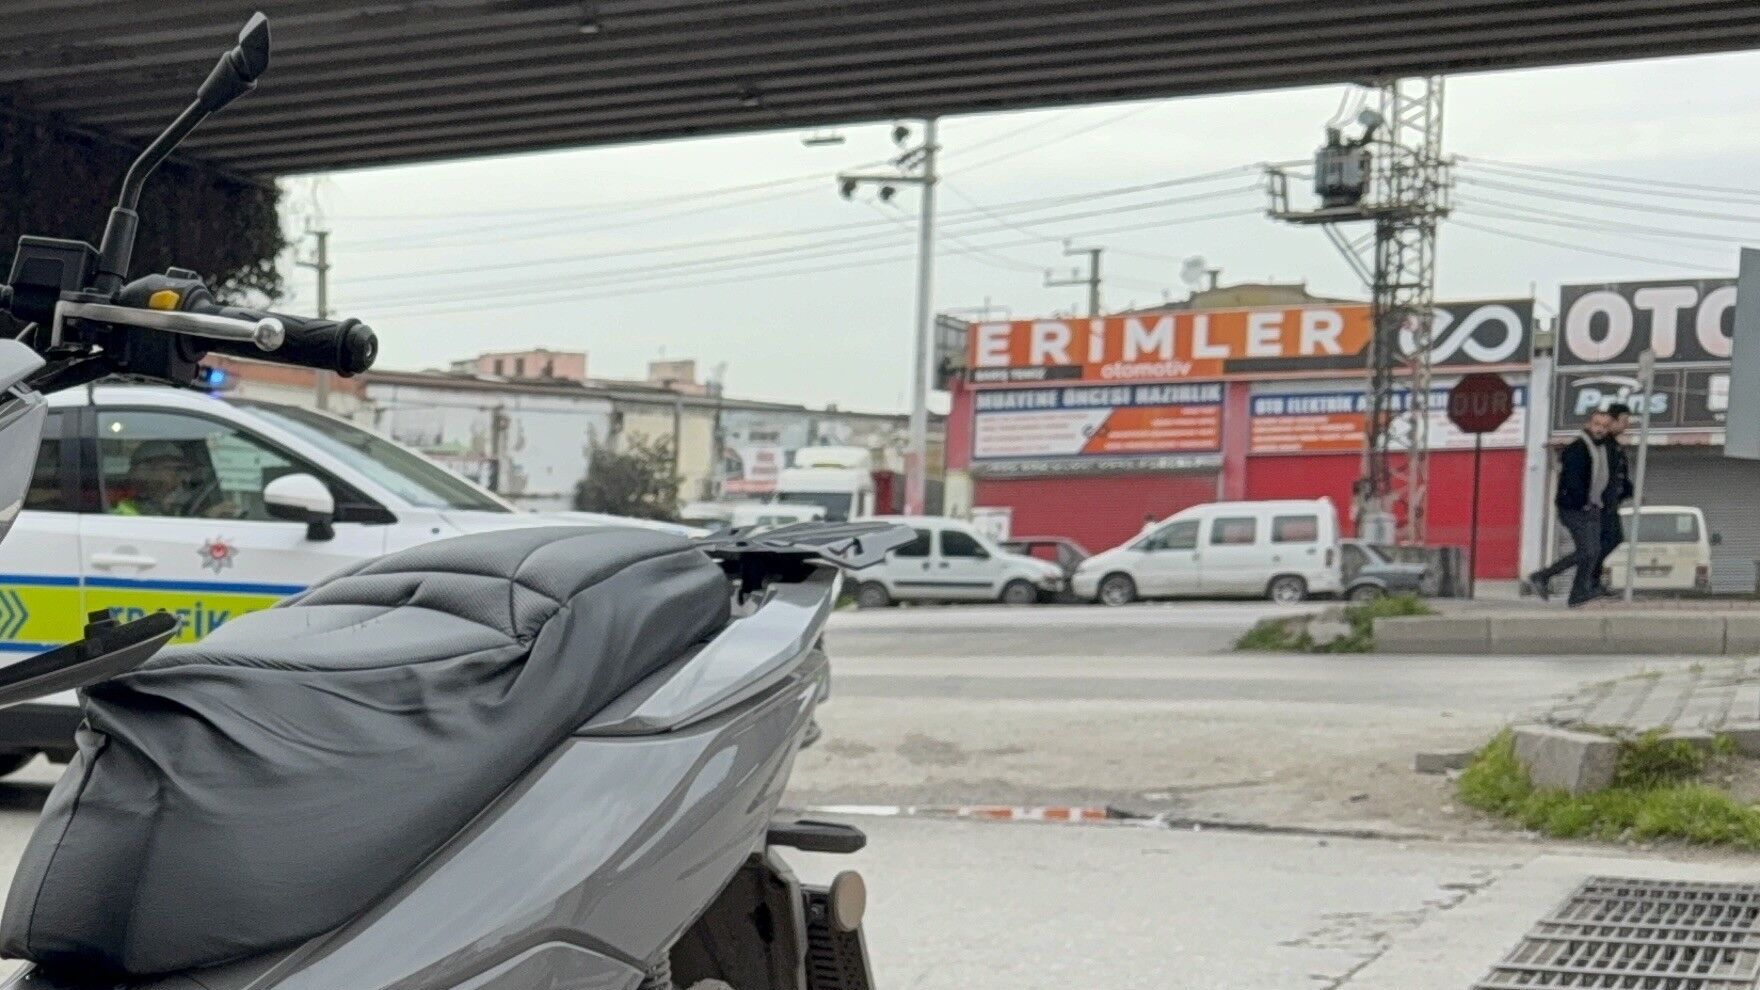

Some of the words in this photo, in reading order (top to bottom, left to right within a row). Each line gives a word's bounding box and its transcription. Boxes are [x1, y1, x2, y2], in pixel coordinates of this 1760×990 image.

[976, 309, 1345, 366] ERİMLER
[1100, 361, 1192, 379] otomotiv
[1135, 383, 1222, 405] HAZIRLIK
[1453, 391, 1508, 417] DUR
